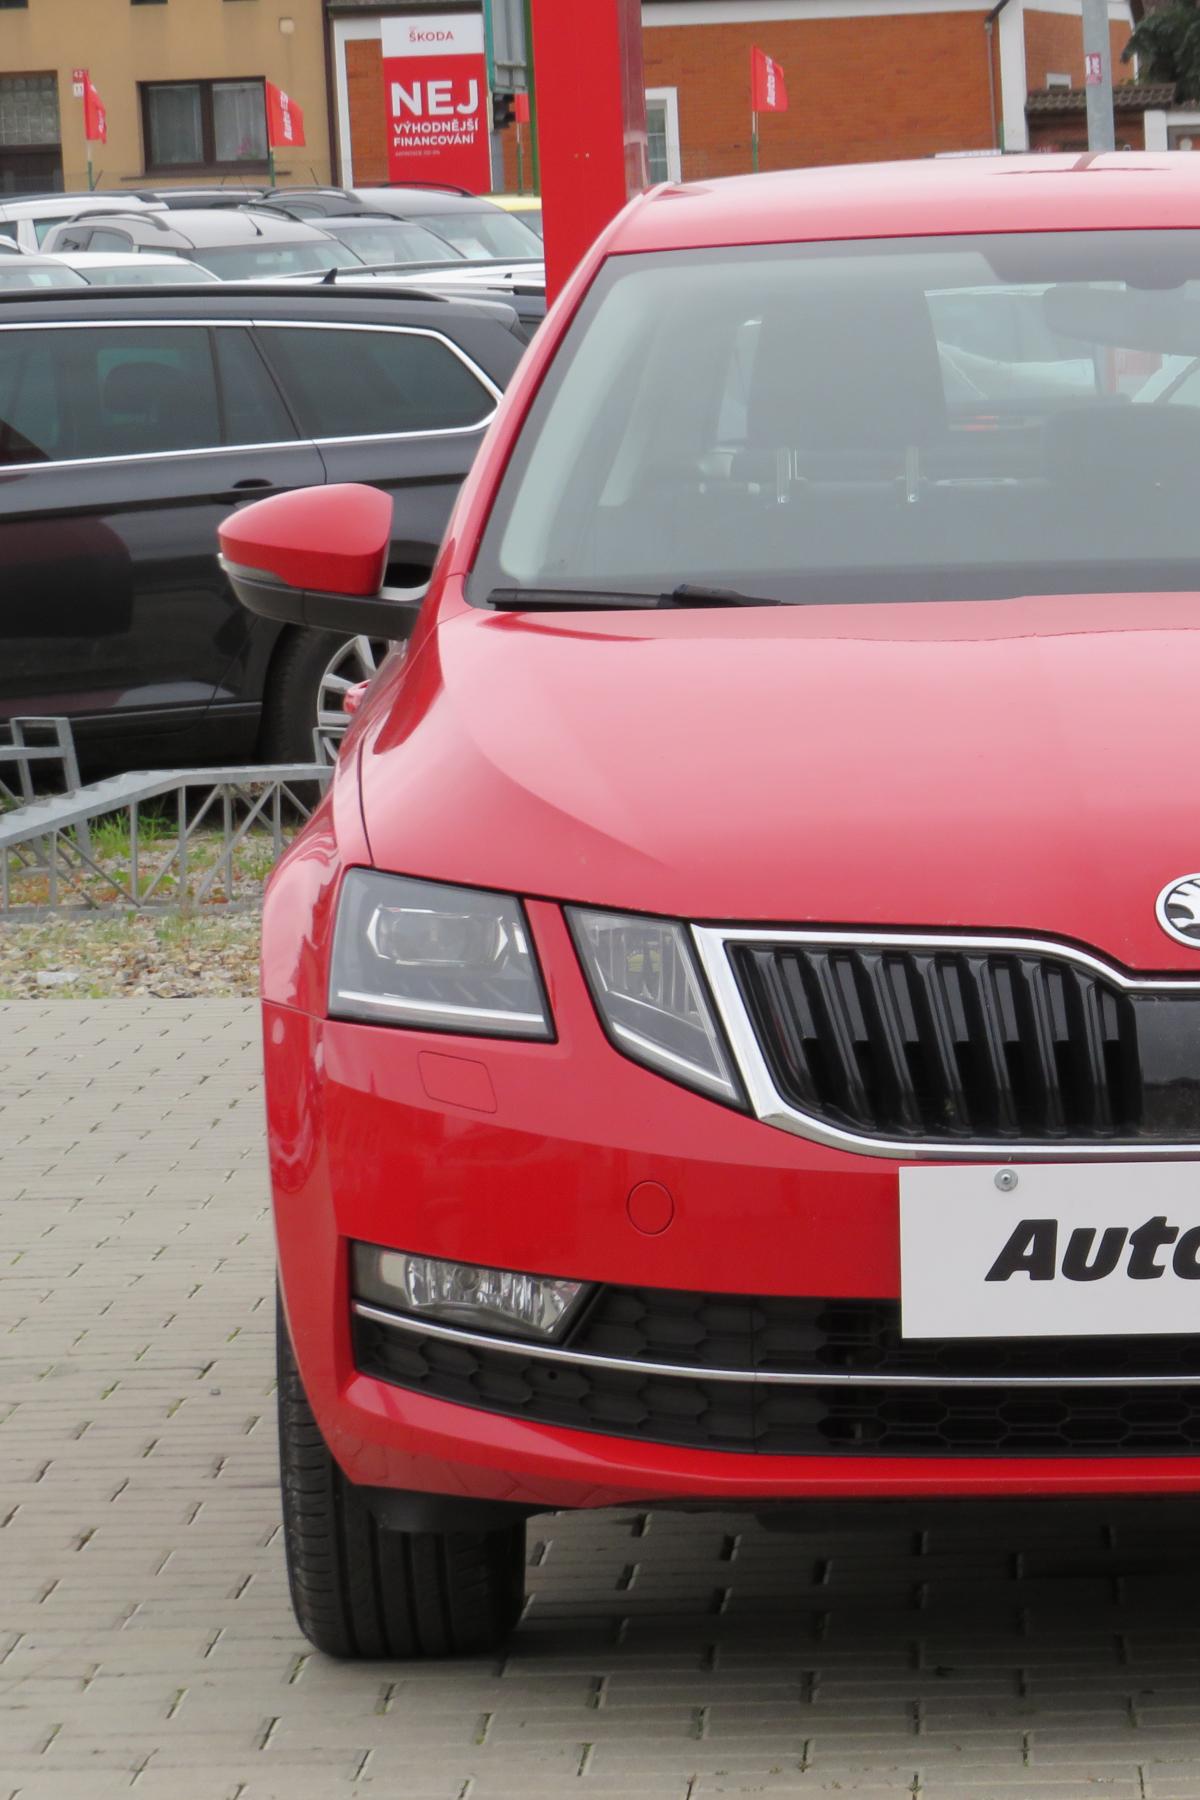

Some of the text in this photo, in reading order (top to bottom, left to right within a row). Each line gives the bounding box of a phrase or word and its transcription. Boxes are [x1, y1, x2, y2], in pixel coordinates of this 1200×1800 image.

[409, 30, 455, 43] ŠKODA
[391, 79, 479, 117] NEJ
[393, 118, 479, 134] VÝHODNĚJŠÍ
[393, 133, 474, 147] FINANCOVÁNÍ
